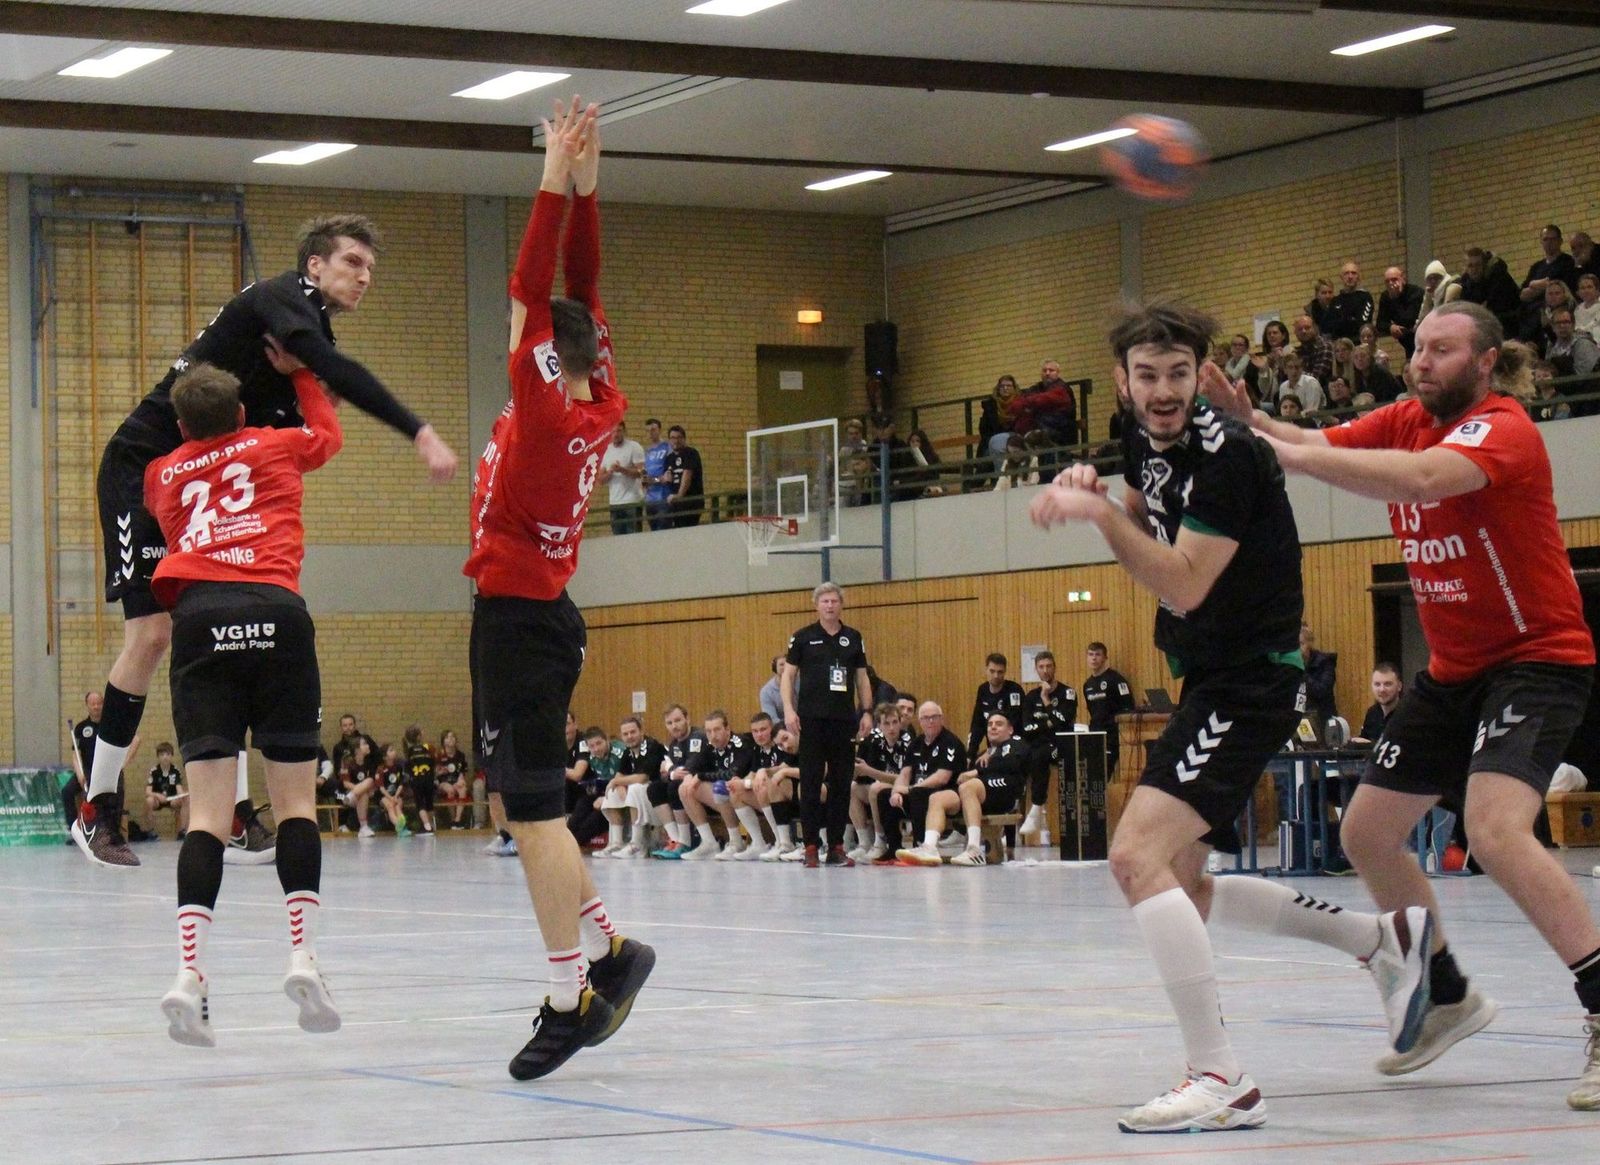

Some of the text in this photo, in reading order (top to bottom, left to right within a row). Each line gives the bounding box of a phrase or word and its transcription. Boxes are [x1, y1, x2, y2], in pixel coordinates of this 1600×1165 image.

[181, 462, 256, 530] 23
[252, 513, 261, 521] in
[213, 521, 261, 533] Schaumburg
[215, 526, 267, 542] und Nienburg
[1398, 534, 1467, 565] acon
[1431, 592, 1468, 603] Zeitung
[211, 623, 260, 641] VGH
[213, 640, 275, 652] André Pape
[833, 670, 843, 683] B
[1376, 741, 1401, 769] 13
